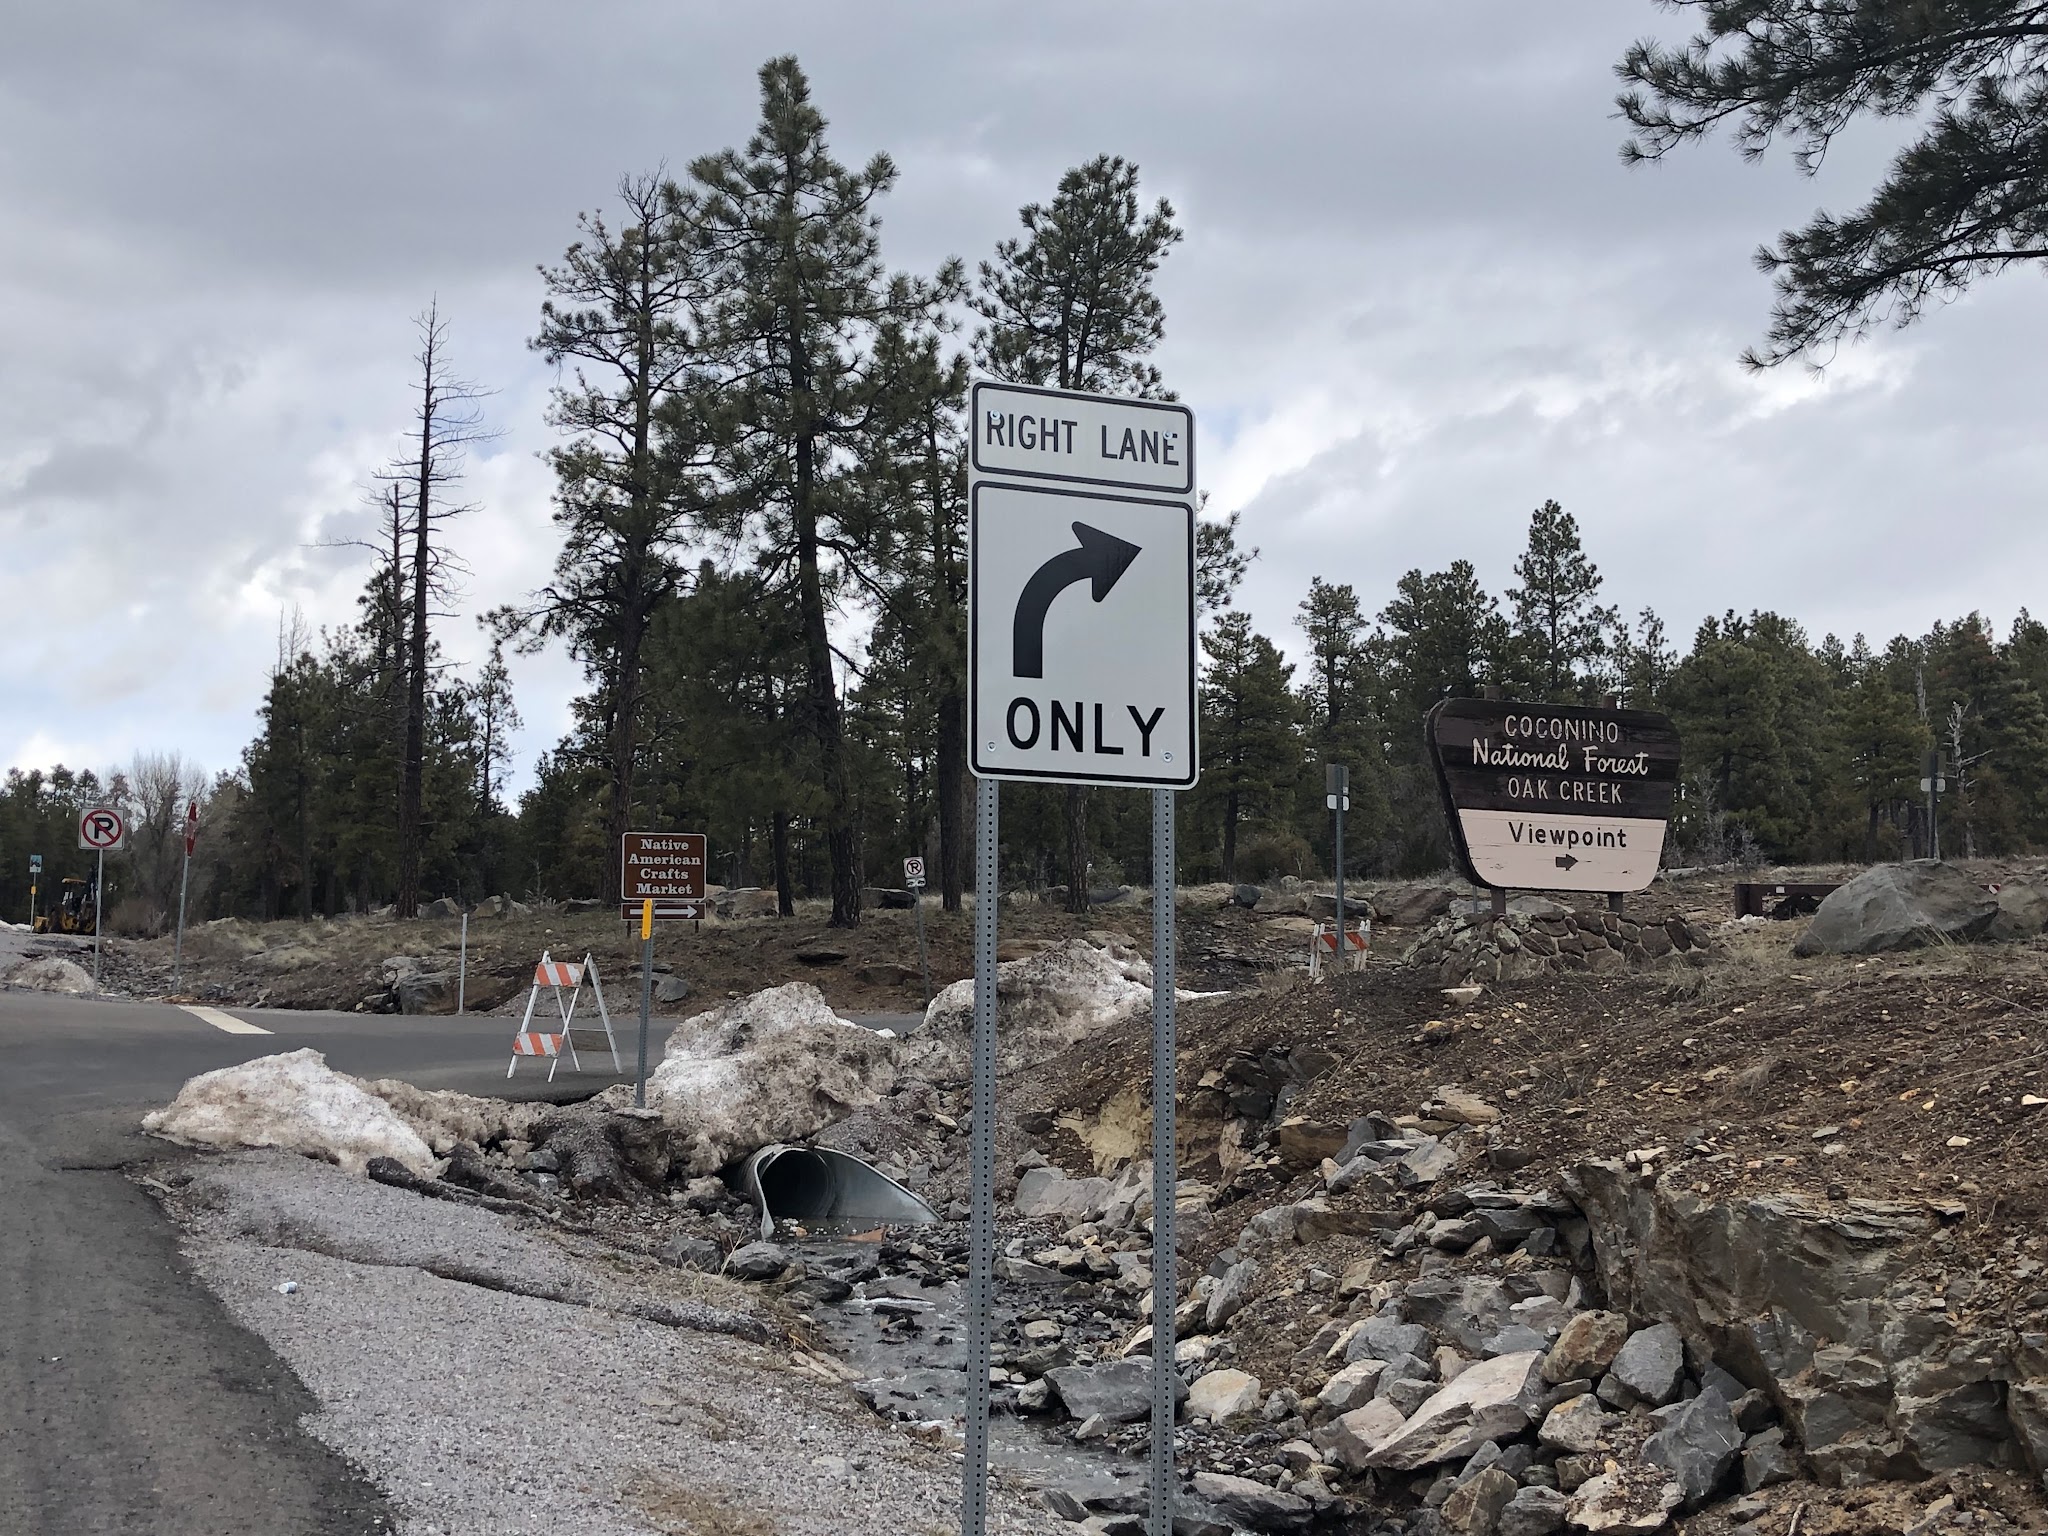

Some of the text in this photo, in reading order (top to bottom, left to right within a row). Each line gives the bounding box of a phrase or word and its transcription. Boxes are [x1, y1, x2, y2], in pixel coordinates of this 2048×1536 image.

[986, 411, 1179, 466] RIGHT LANE
[1006, 697, 1166, 757] ONLY
[1505, 714, 1619, 744] COCONINO
[1472, 737, 1650, 776] National Forest
[1508, 777, 1623, 804] OAK CREEK
[640, 838, 689, 850] Native
[1508, 822, 1628, 850] Viewpoint
[628, 853, 701, 866] American
[640, 868, 689, 880] Crafts
[636, 883, 693, 895] Market
